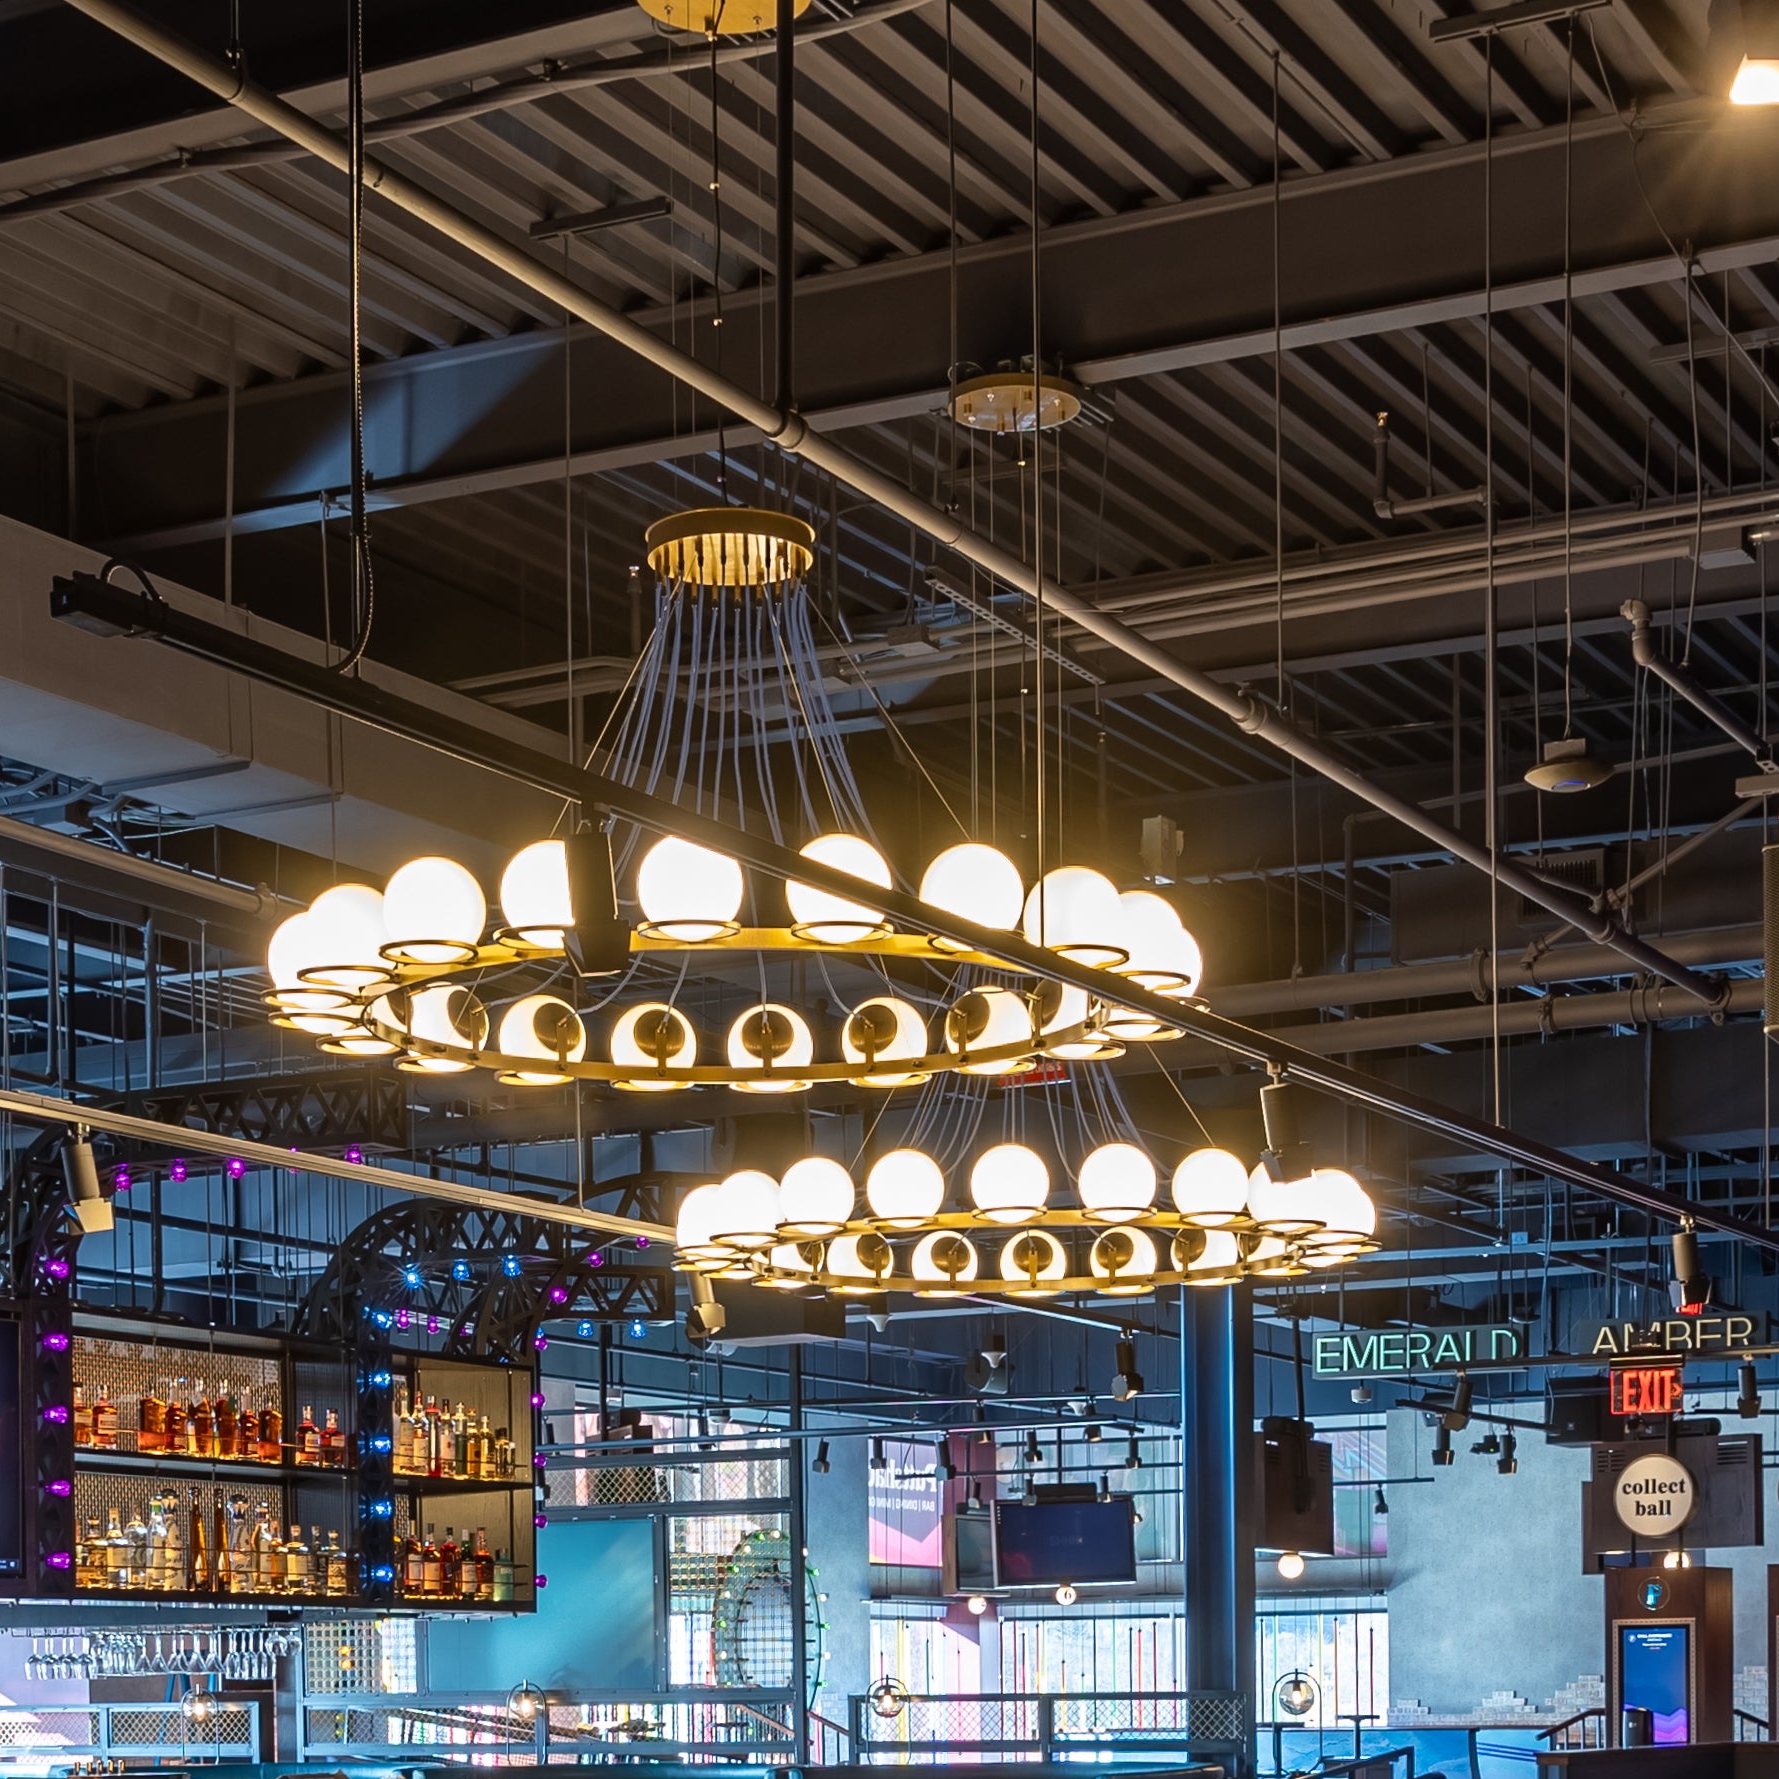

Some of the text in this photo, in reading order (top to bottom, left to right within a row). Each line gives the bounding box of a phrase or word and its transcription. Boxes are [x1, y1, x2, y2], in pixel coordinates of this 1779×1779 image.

[1316, 1330, 1518, 1374] EMERALD
[1592, 1316, 1752, 1354] AMBER
[1623, 1369, 1677, 1410] EXIT
[1622, 1478, 1685, 1495] collect
[1635, 1500, 1671, 1517] ball
